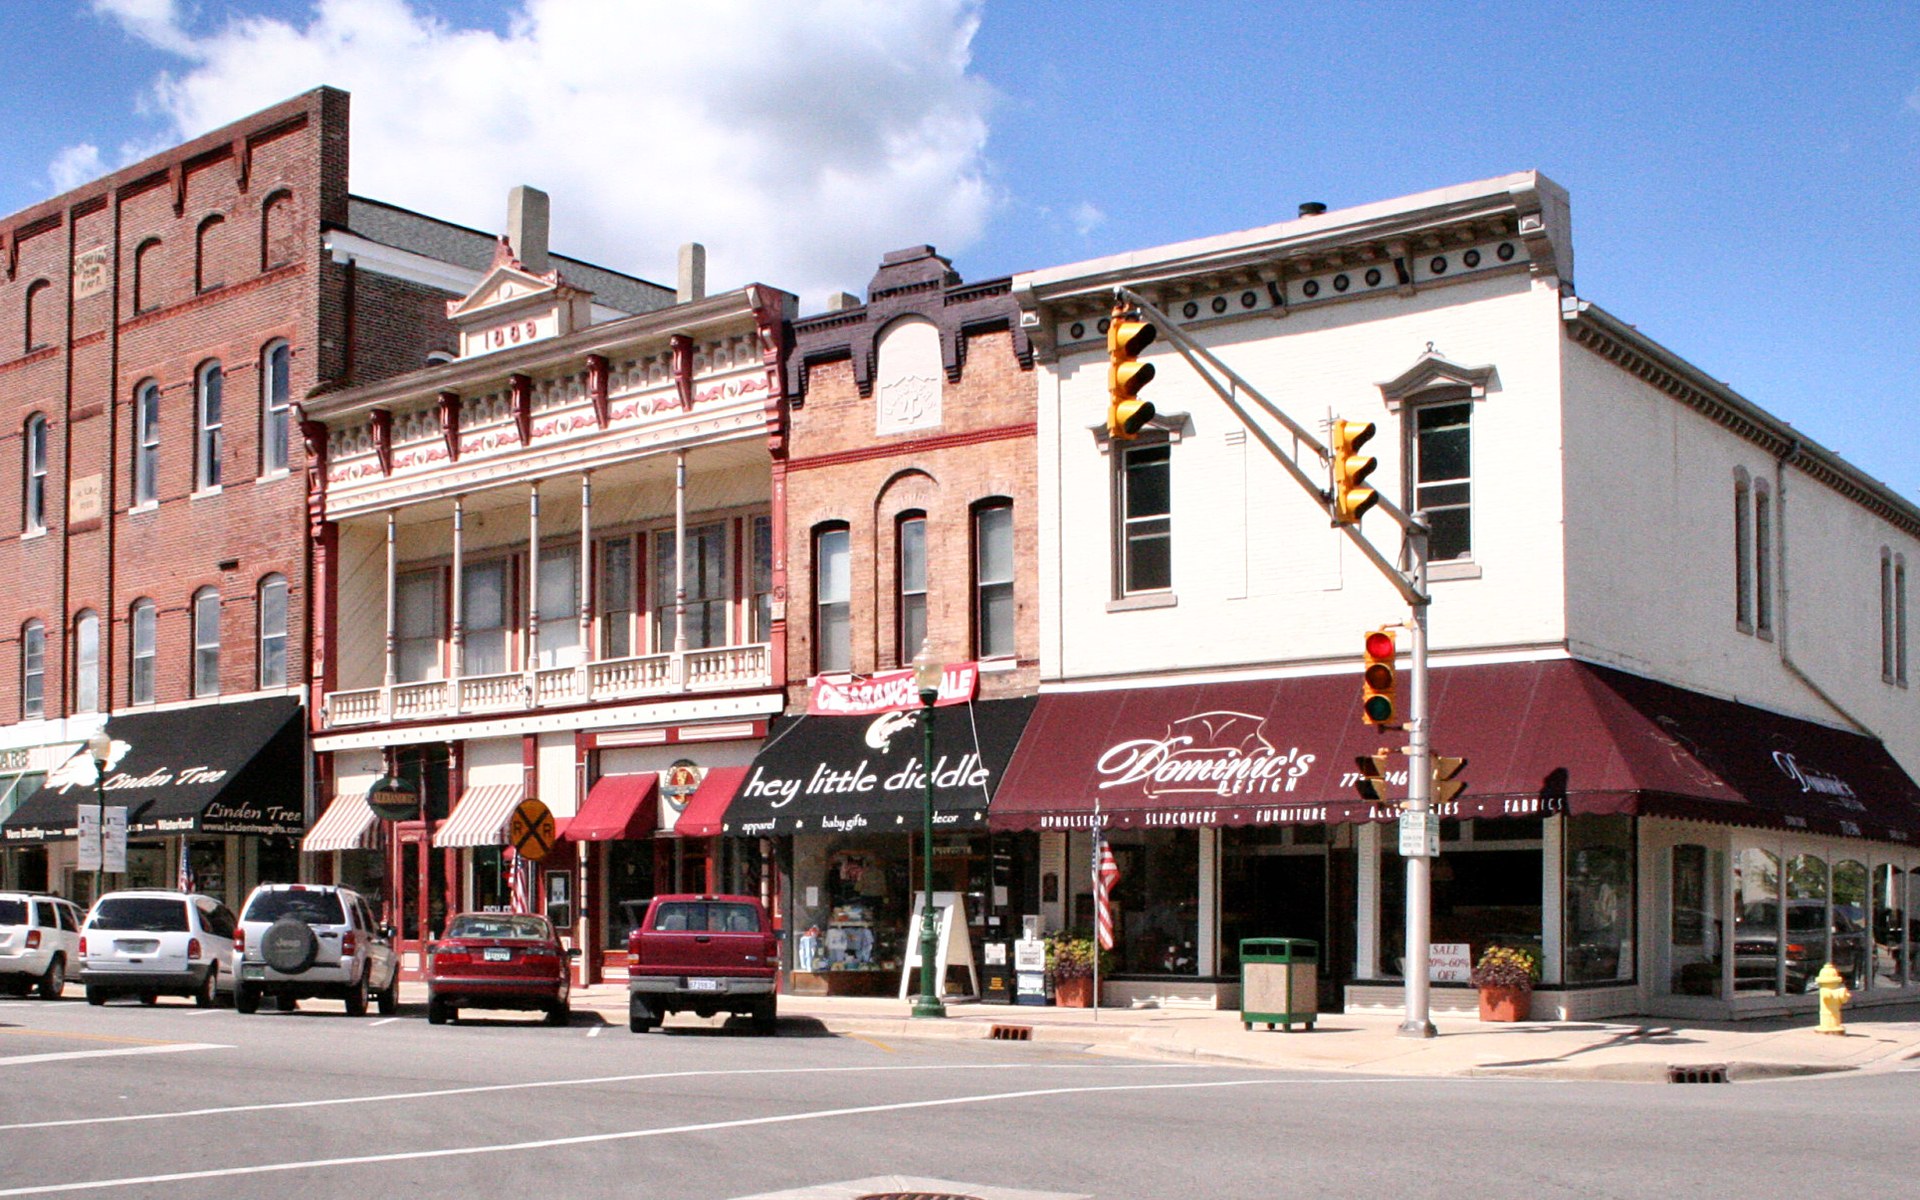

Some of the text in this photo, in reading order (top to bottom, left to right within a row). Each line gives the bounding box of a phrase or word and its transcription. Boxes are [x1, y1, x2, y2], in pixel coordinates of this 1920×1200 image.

[937, 669, 972, 699] ALE
[1097, 735, 1316, 788] Dominic's
[93, 766, 227, 791] Linden Tree
[743, 754, 990, 808] hey little diddle
[1217, 777, 1297, 795] DESIGN
[204, 801, 302, 821] Linden Tree
[1145, 811, 1217, 825] SLIPCOVERS
[1256, 807, 1327, 823] FURNITURE
[1504, 798, 1563, 813] FABRICS
[543, 822, 552, 838] R
[742, 818, 776, 835] apparel
